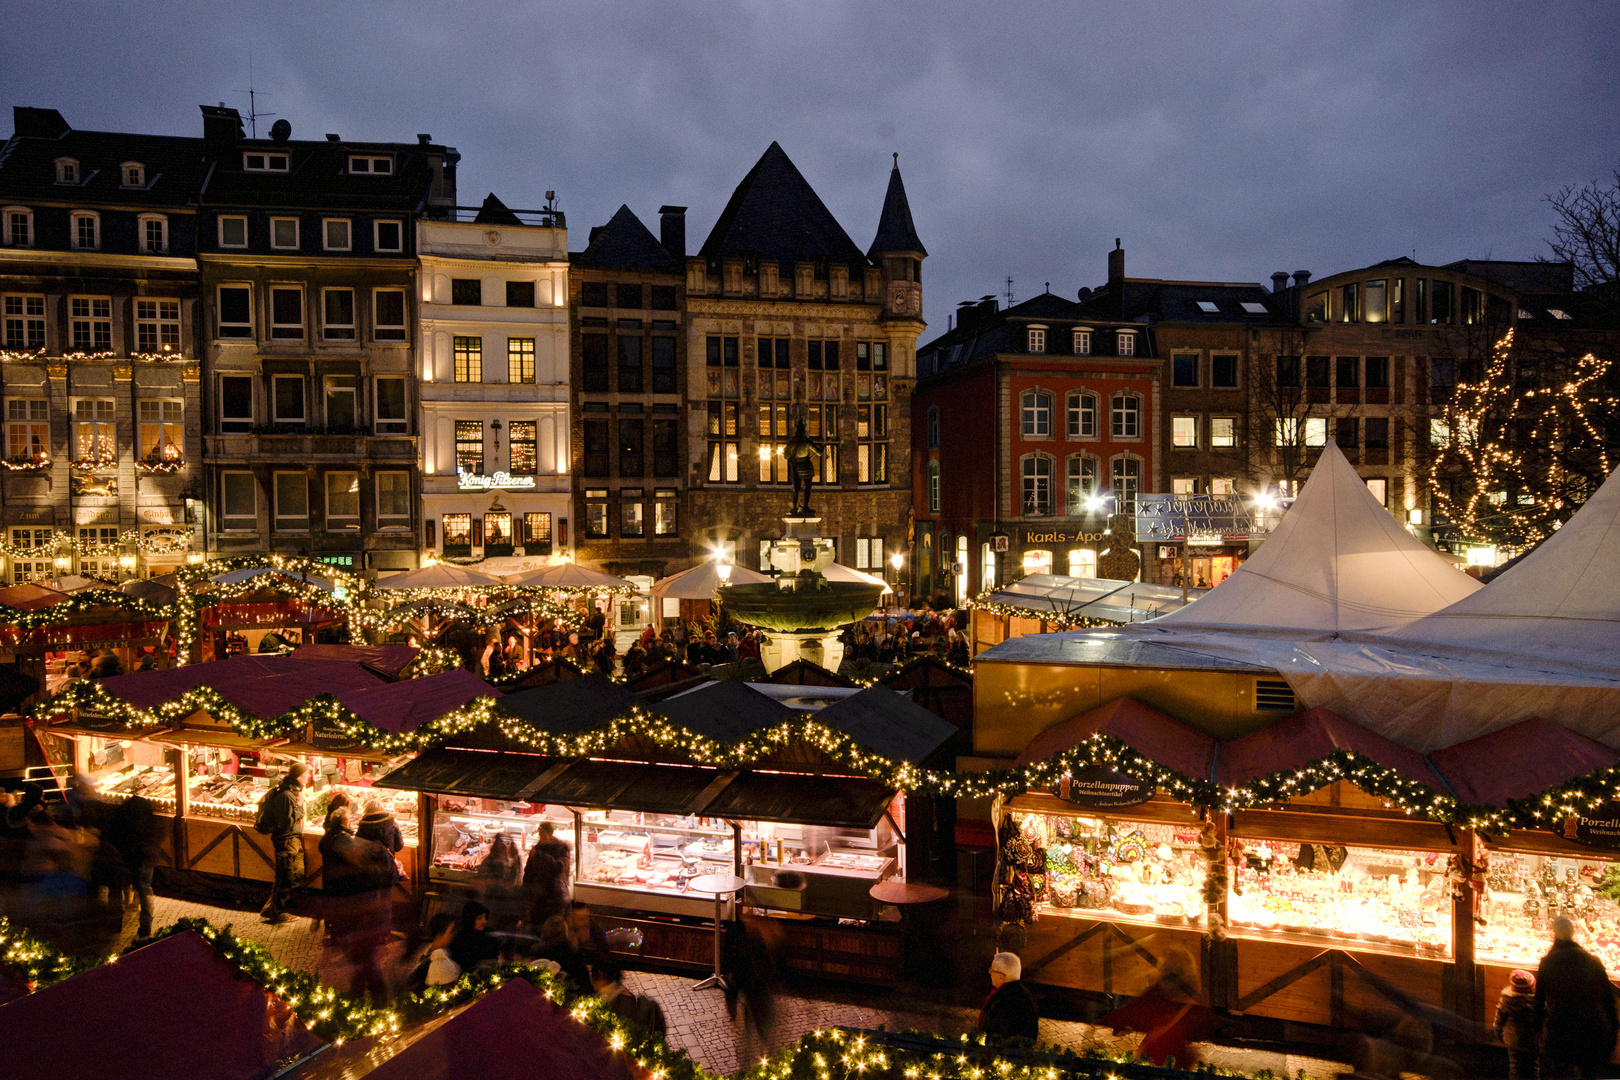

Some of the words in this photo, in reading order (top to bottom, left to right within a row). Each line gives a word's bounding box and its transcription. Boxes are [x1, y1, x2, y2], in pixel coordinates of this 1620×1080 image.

[19, 511, 40, 520] Zum
[144, 510, 180, 520] Einhorn
[1072, 779, 1139, 792] Porzellanpuppen
[1580, 816, 1620, 828] Porzell
